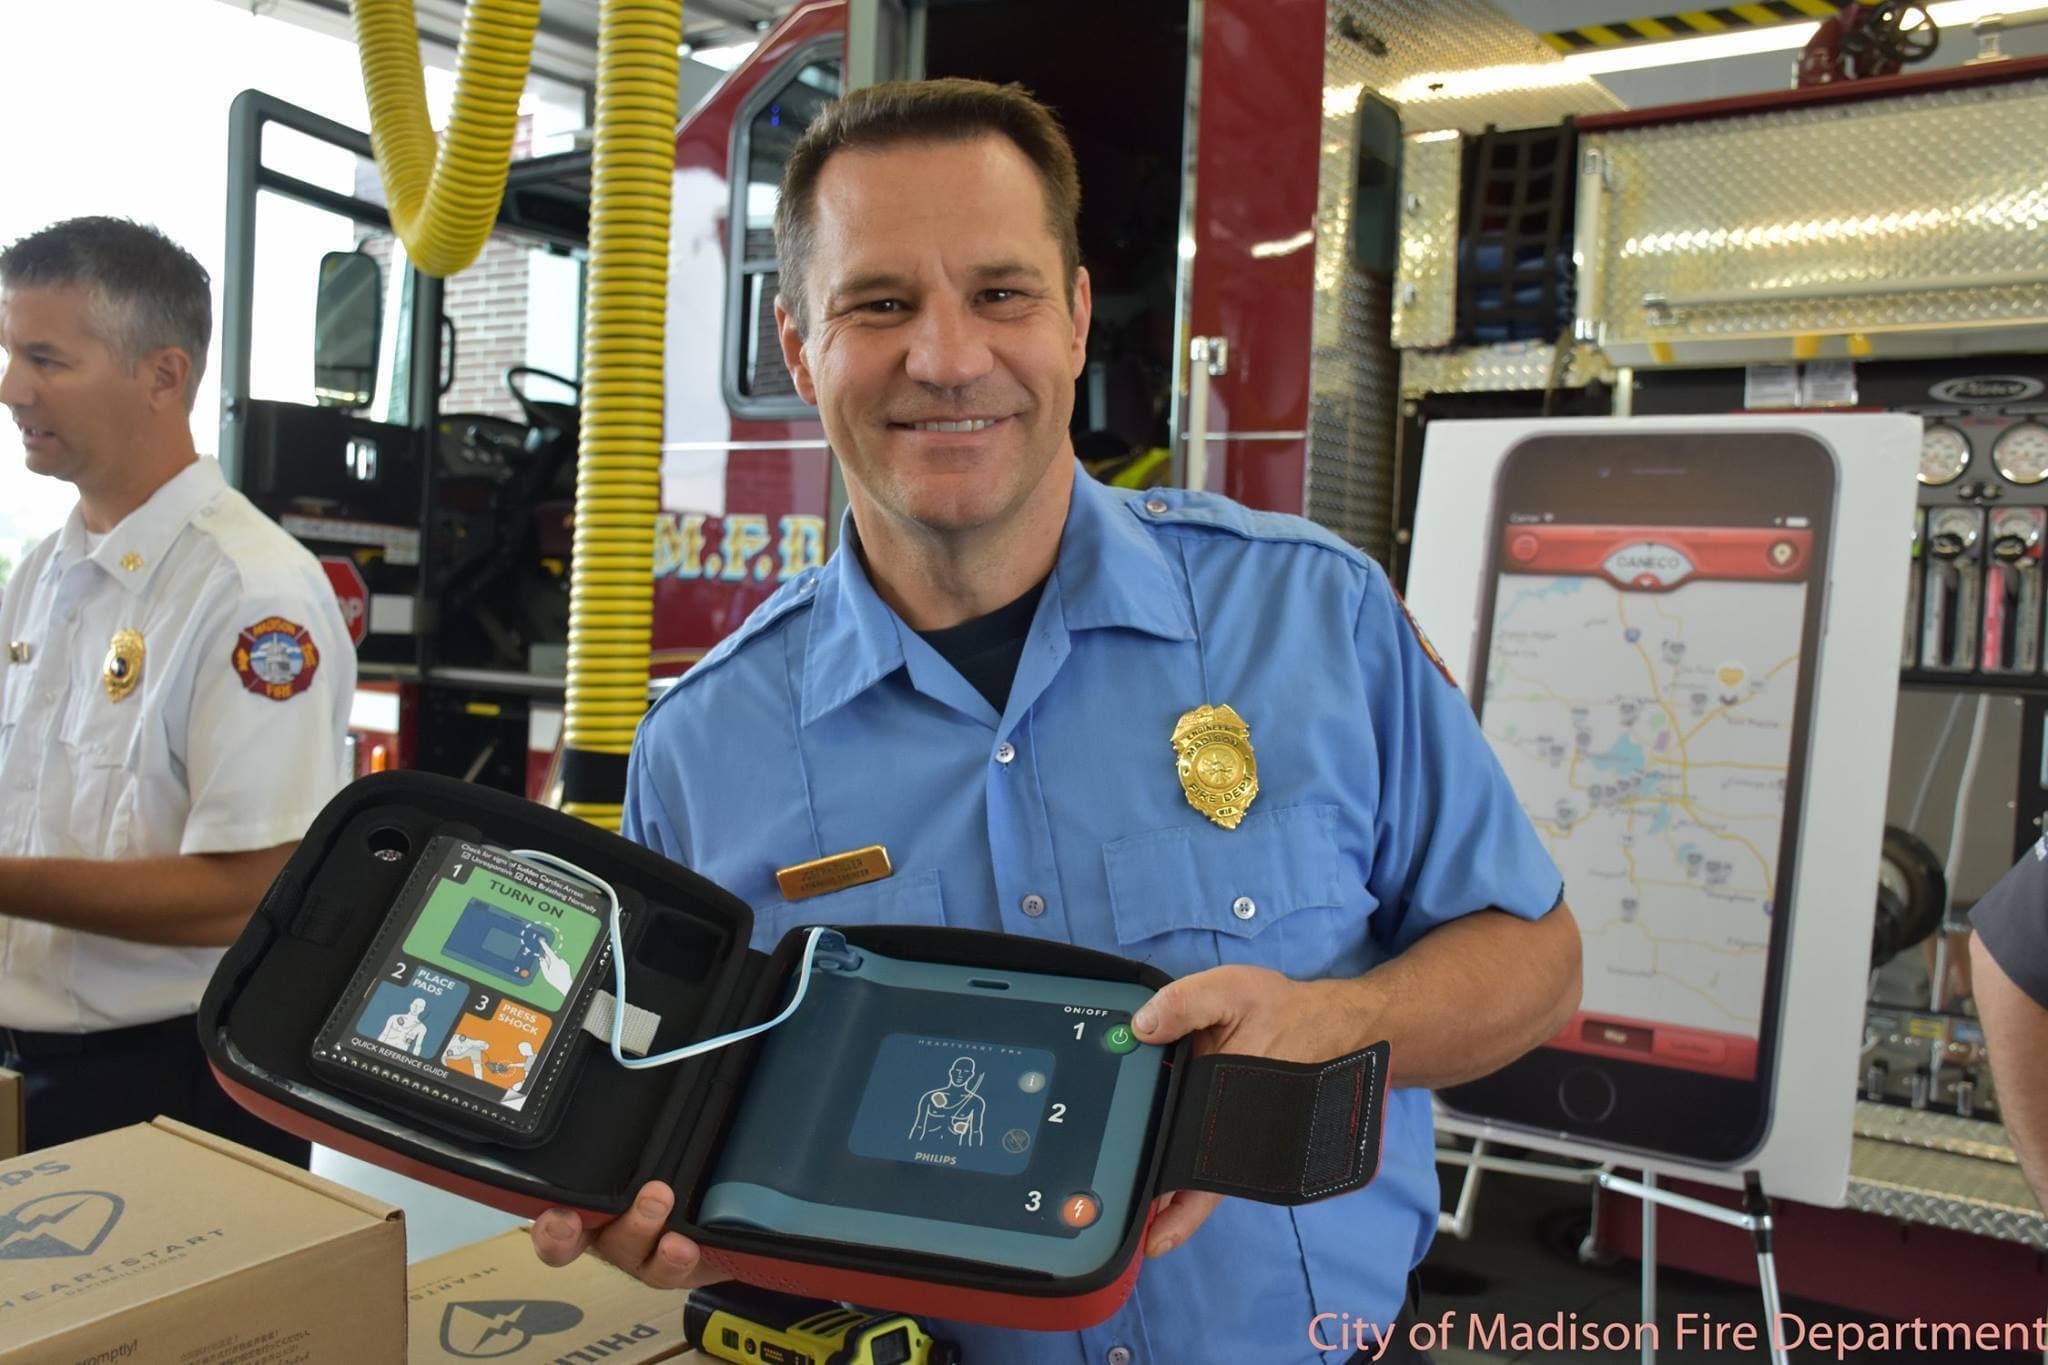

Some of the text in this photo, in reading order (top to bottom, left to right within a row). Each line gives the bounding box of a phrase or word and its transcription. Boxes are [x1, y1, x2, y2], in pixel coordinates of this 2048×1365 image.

[1187, 735, 1239, 758] MADISON
[1188, 782, 1216, 803] FIRE
[461, 843, 481, 855] Check
[516, 863, 539, 878] Sudden
[453, 864, 462, 878] 1
[524, 876, 538, 888] Not
[490, 879, 564, 919] TURN ON
[391, 962, 407, 979] 2
[418, 969, 456, 990] PLACE
[412, 978, 443, 996] PADS
[475, 995, 490, 1011] 3
[1064, 1006, 1109, 1017] ON/OFF
[502, 1004, 538, 1023] PRESS
[498, 1013, 539, 1035] SHOCK
[1073, 1022, 1085, 1040] 1
[351, 1037, 449, 1079] QUICK REFERENCE GUIDE
[1048, 1103, 1067, 1123] 2
[914, 1151, 957, 1165] PHILIPS
[1024, 1191, 1042, 1212] 3
